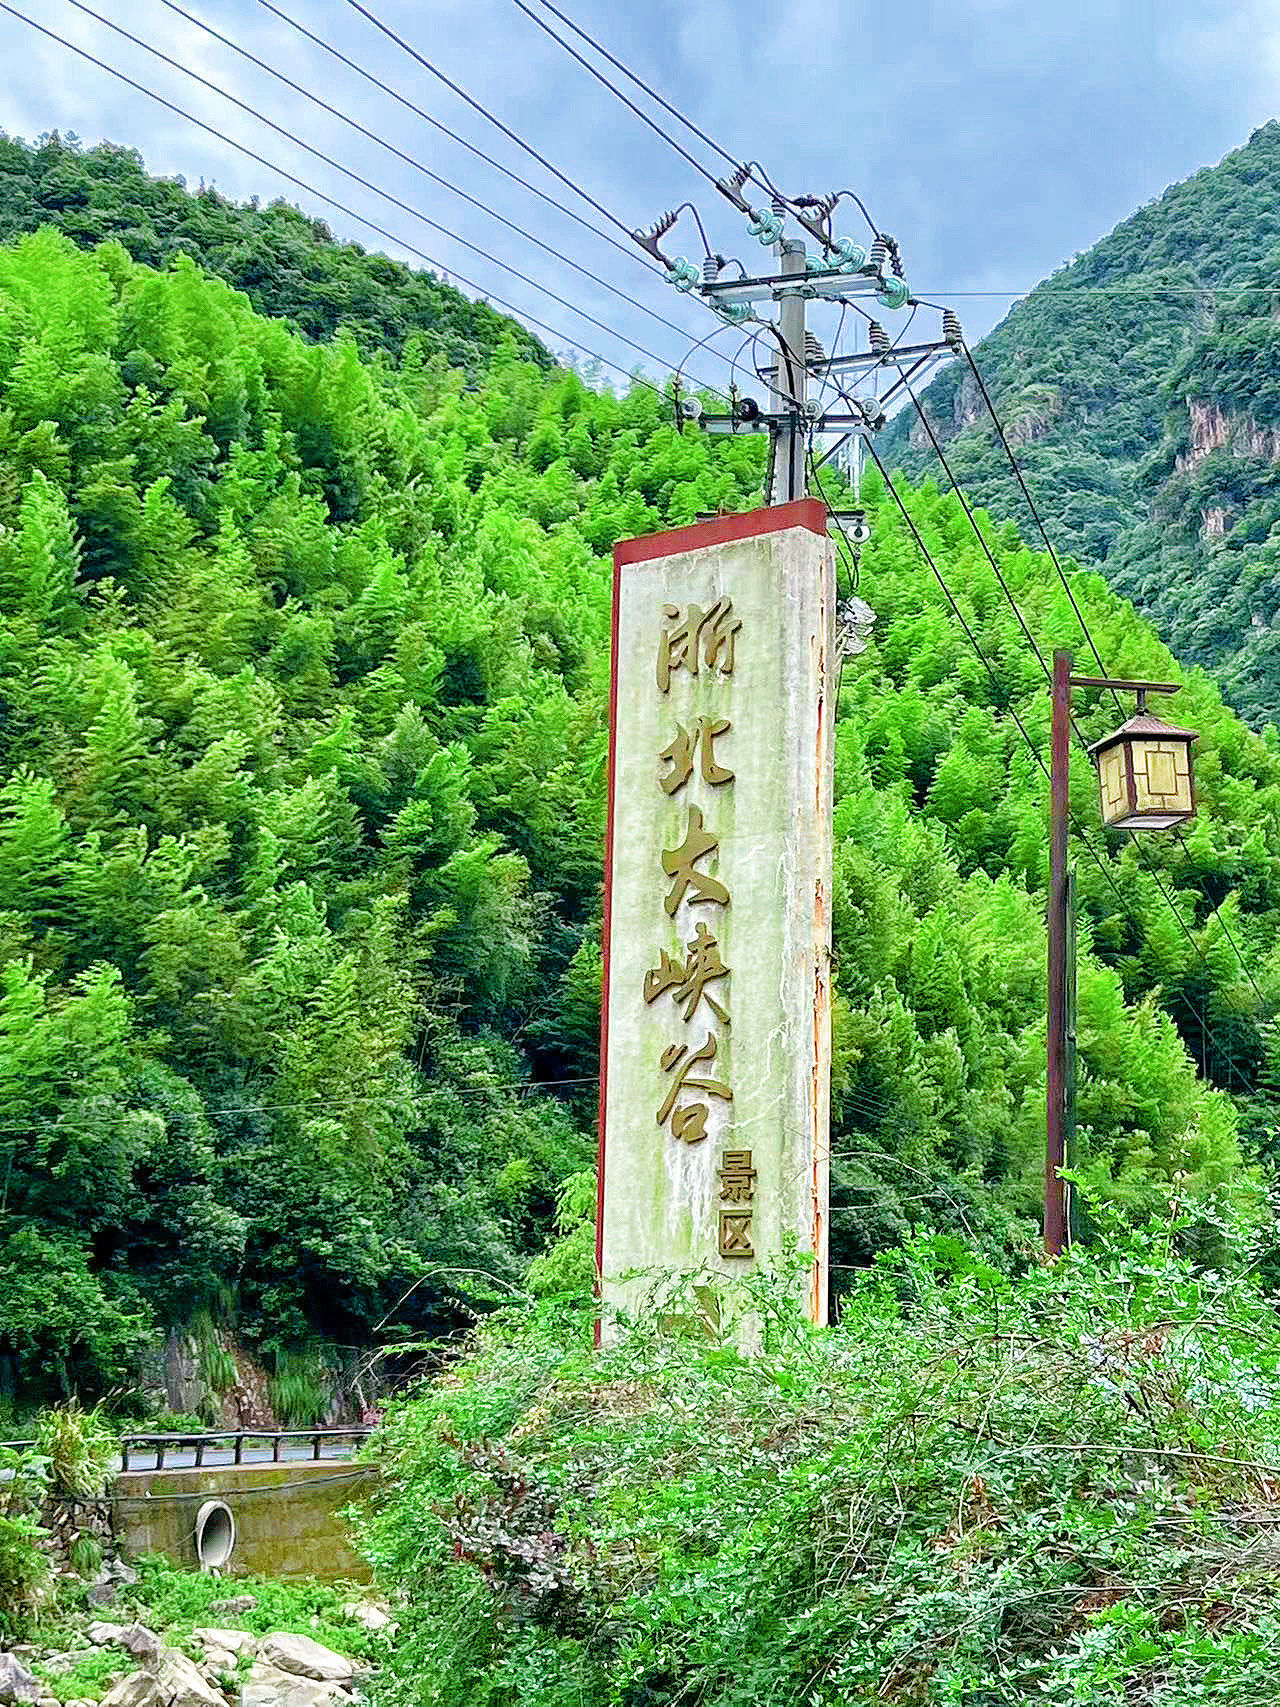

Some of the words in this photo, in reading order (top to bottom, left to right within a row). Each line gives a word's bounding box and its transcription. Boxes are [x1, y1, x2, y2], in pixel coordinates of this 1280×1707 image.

[644, 595, 742, 1144] 浙北大峡谷
[717, 1150, 757, 1258] 景区
